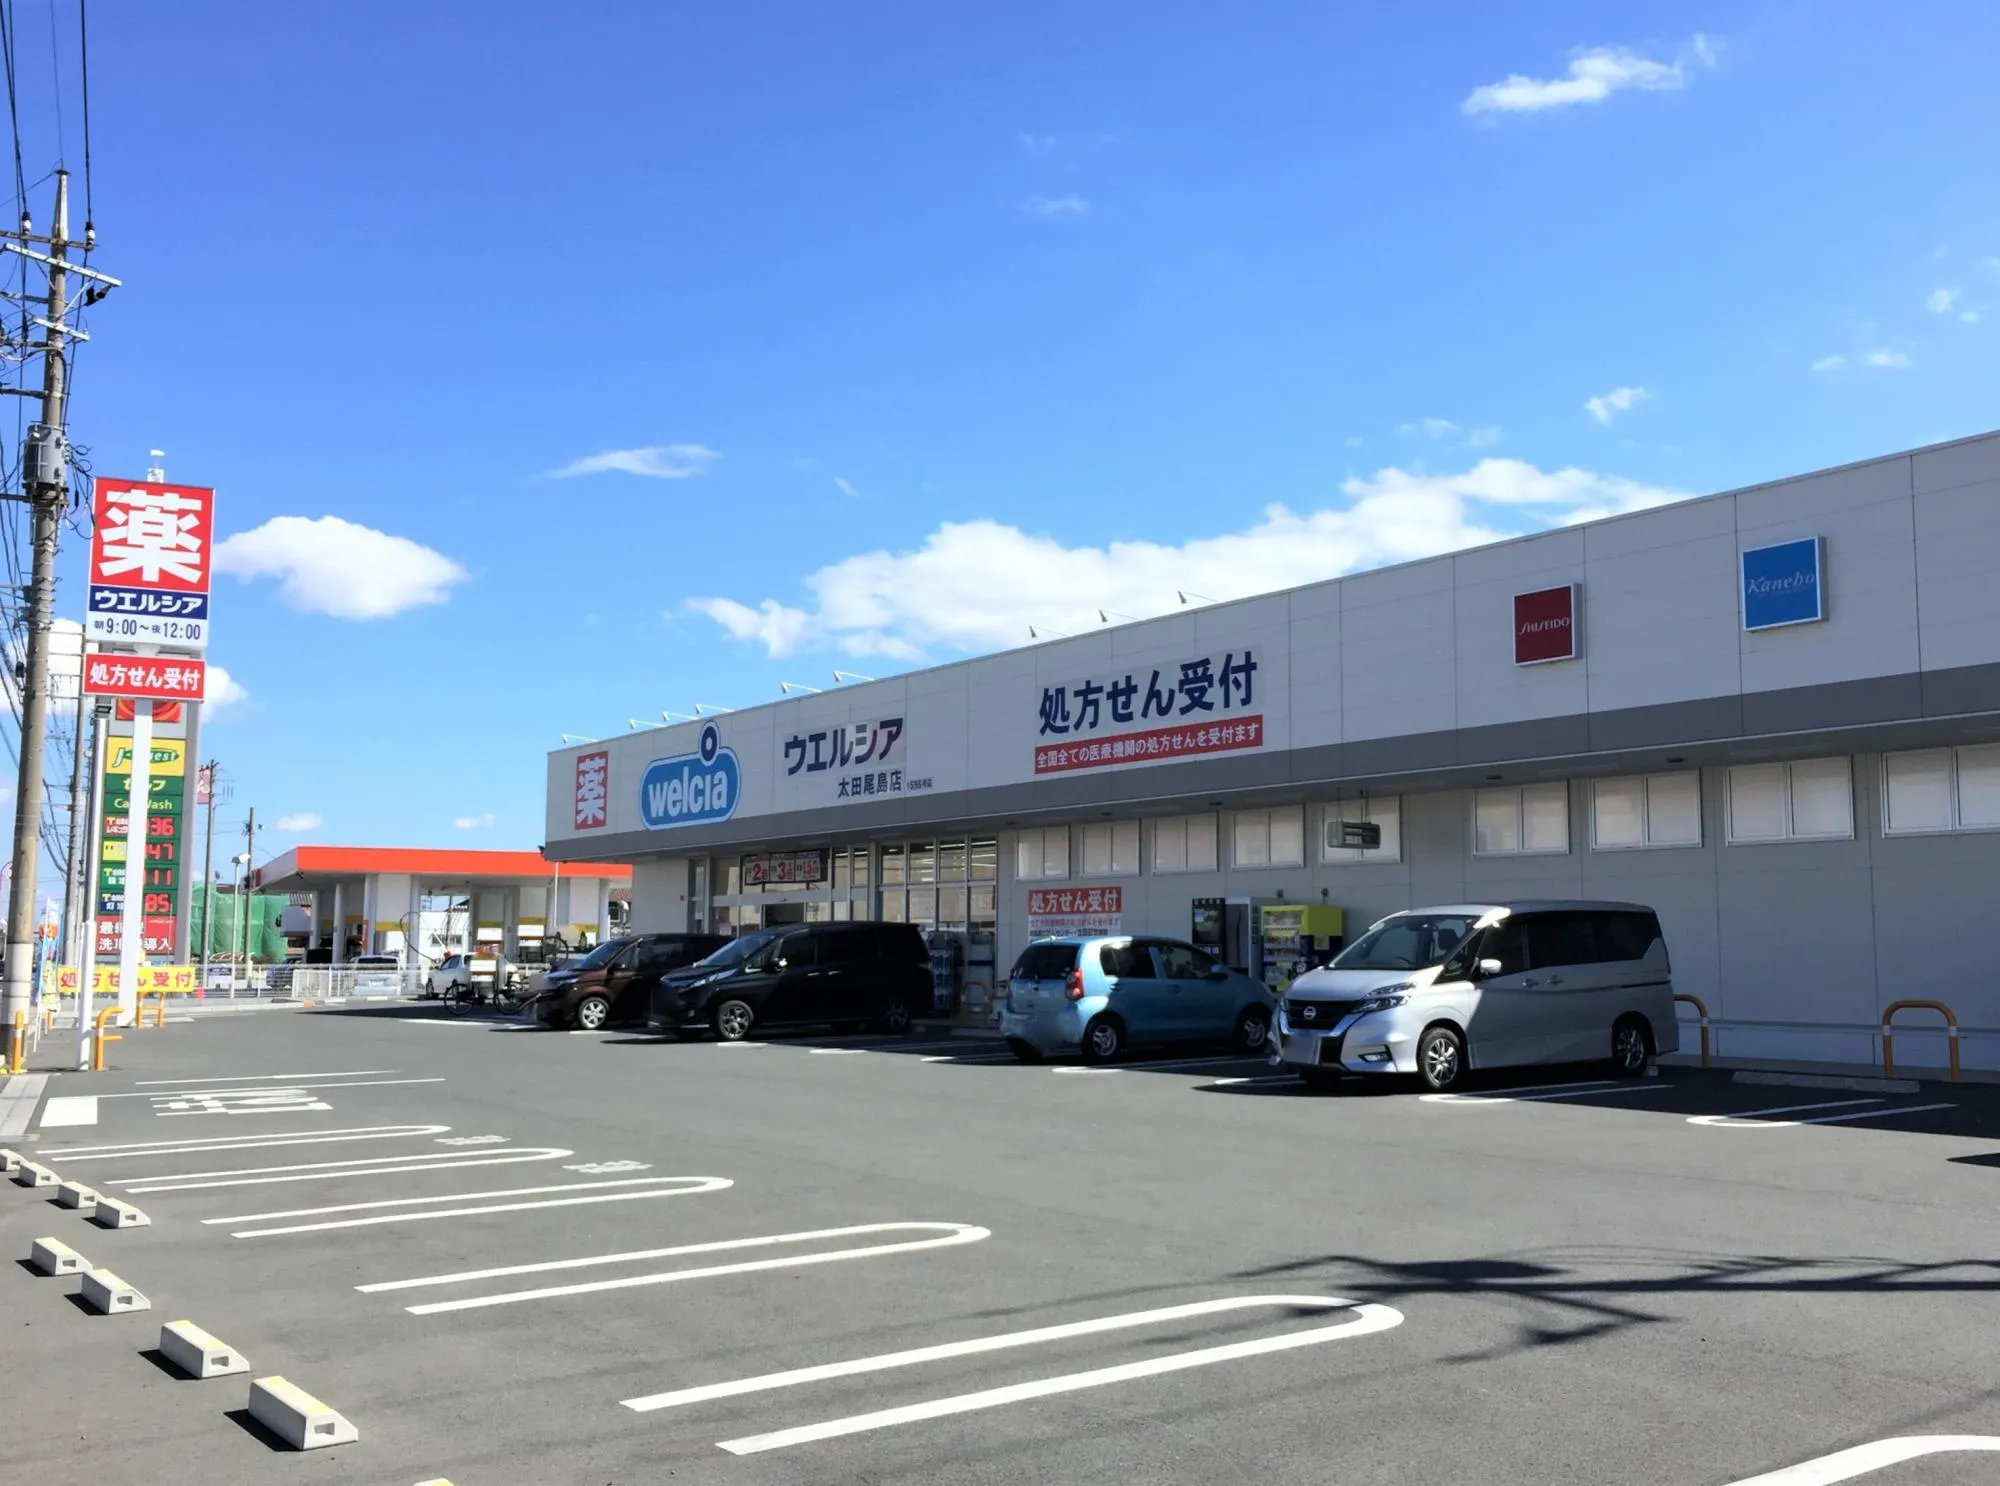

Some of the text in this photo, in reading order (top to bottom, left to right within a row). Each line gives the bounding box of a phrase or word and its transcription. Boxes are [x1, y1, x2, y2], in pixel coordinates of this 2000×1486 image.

[98, 489, 203, 584] 薬
[1747, 571, 1815, 594] Kanebo
[95, 590, 203, 614] ウエルシア
[1518, 616, 1570, 636] SHISEIDO
[90, 662, 200, 691] 処方せん受付
[1039, 651, 1258, 736] 処方せん受付
[784, 717, 903, 776] ウエルシア
[1037, 722, 1259, 768] 全国全ての医療機関の処方せんを受付ます
[576, 754, 606, 826] 薬
[648, 766, 727, 818] welcia
[838, 770, 902, 798] 太田尾島店
[1031, 889, 1118, 913] 処方せん受付
